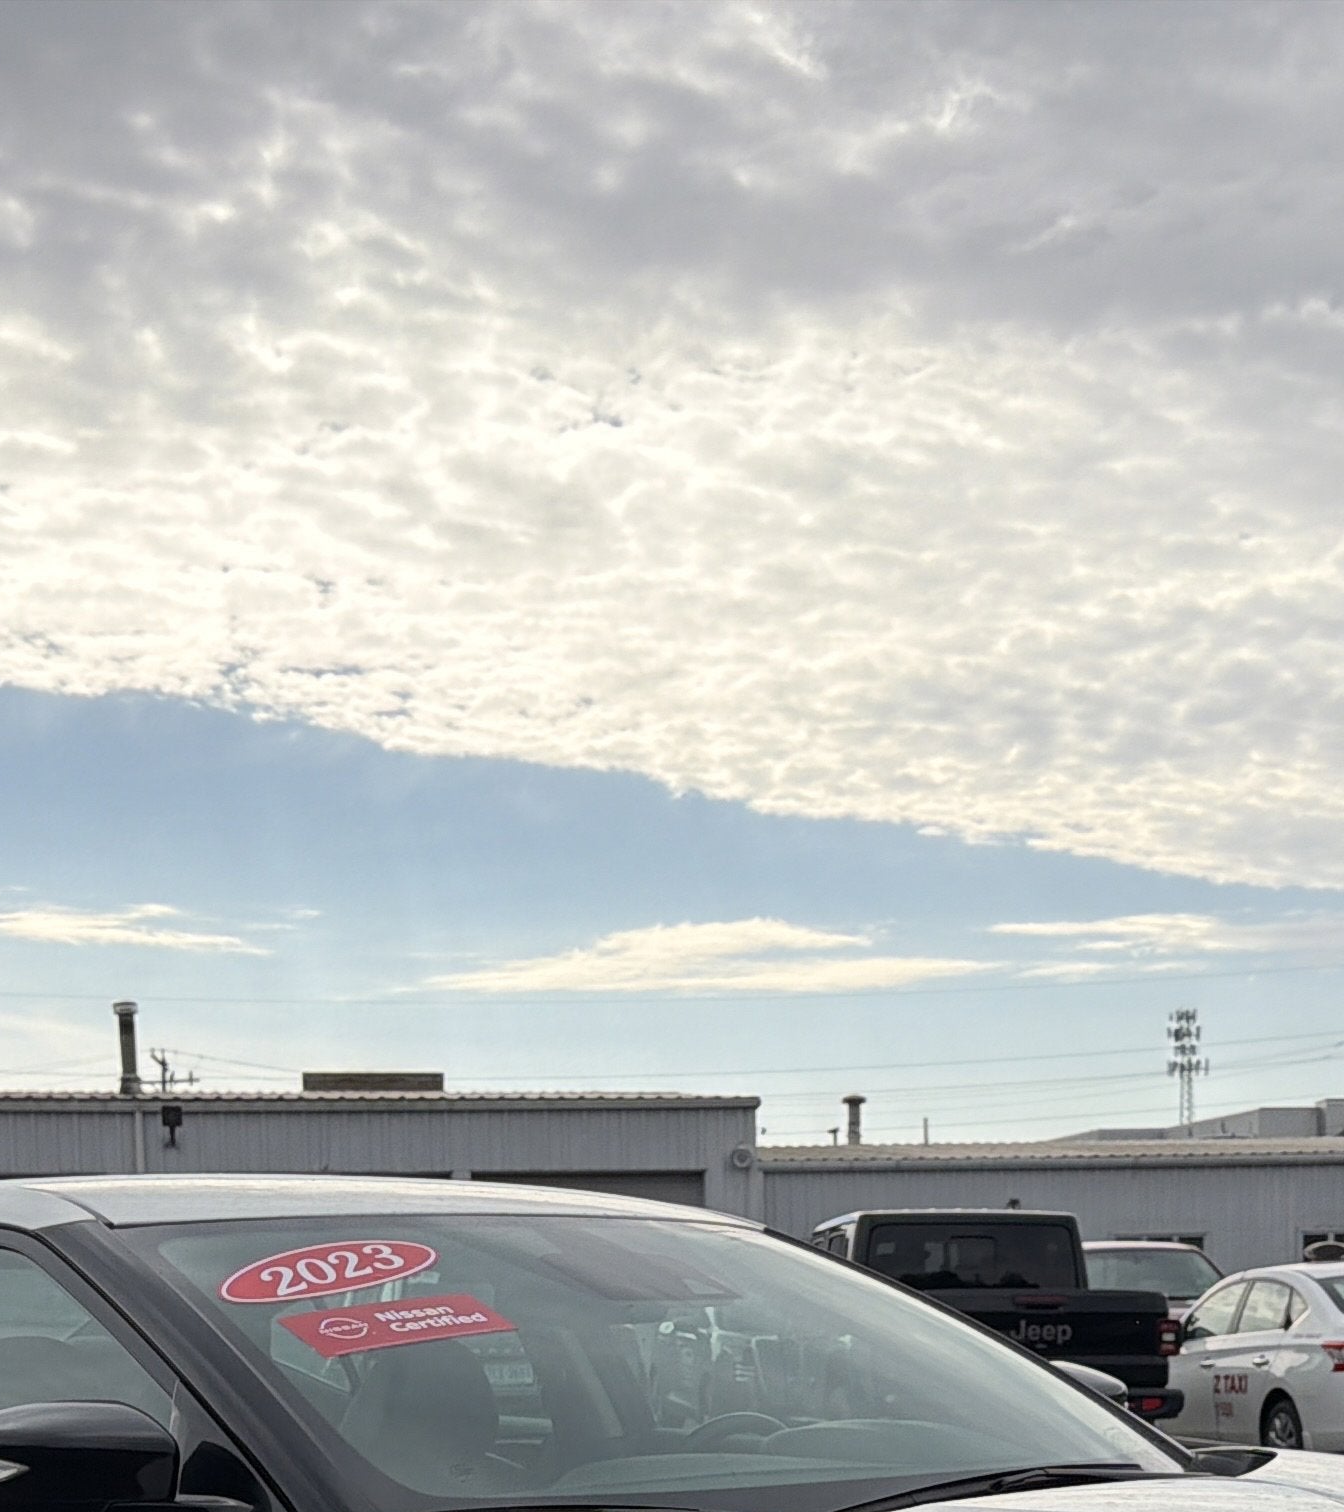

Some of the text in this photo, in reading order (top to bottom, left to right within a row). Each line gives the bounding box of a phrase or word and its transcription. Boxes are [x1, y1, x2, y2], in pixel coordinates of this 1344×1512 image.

[260, 1244, 404, 1296] 2023
[373, 1305, 454, 1322] Nissan
[389, 1313, 488, 1332] Certified
[1009, 1319, 1072, 1344] Jeep
[1213, 1374, 1248, 1394] Z TAXI
